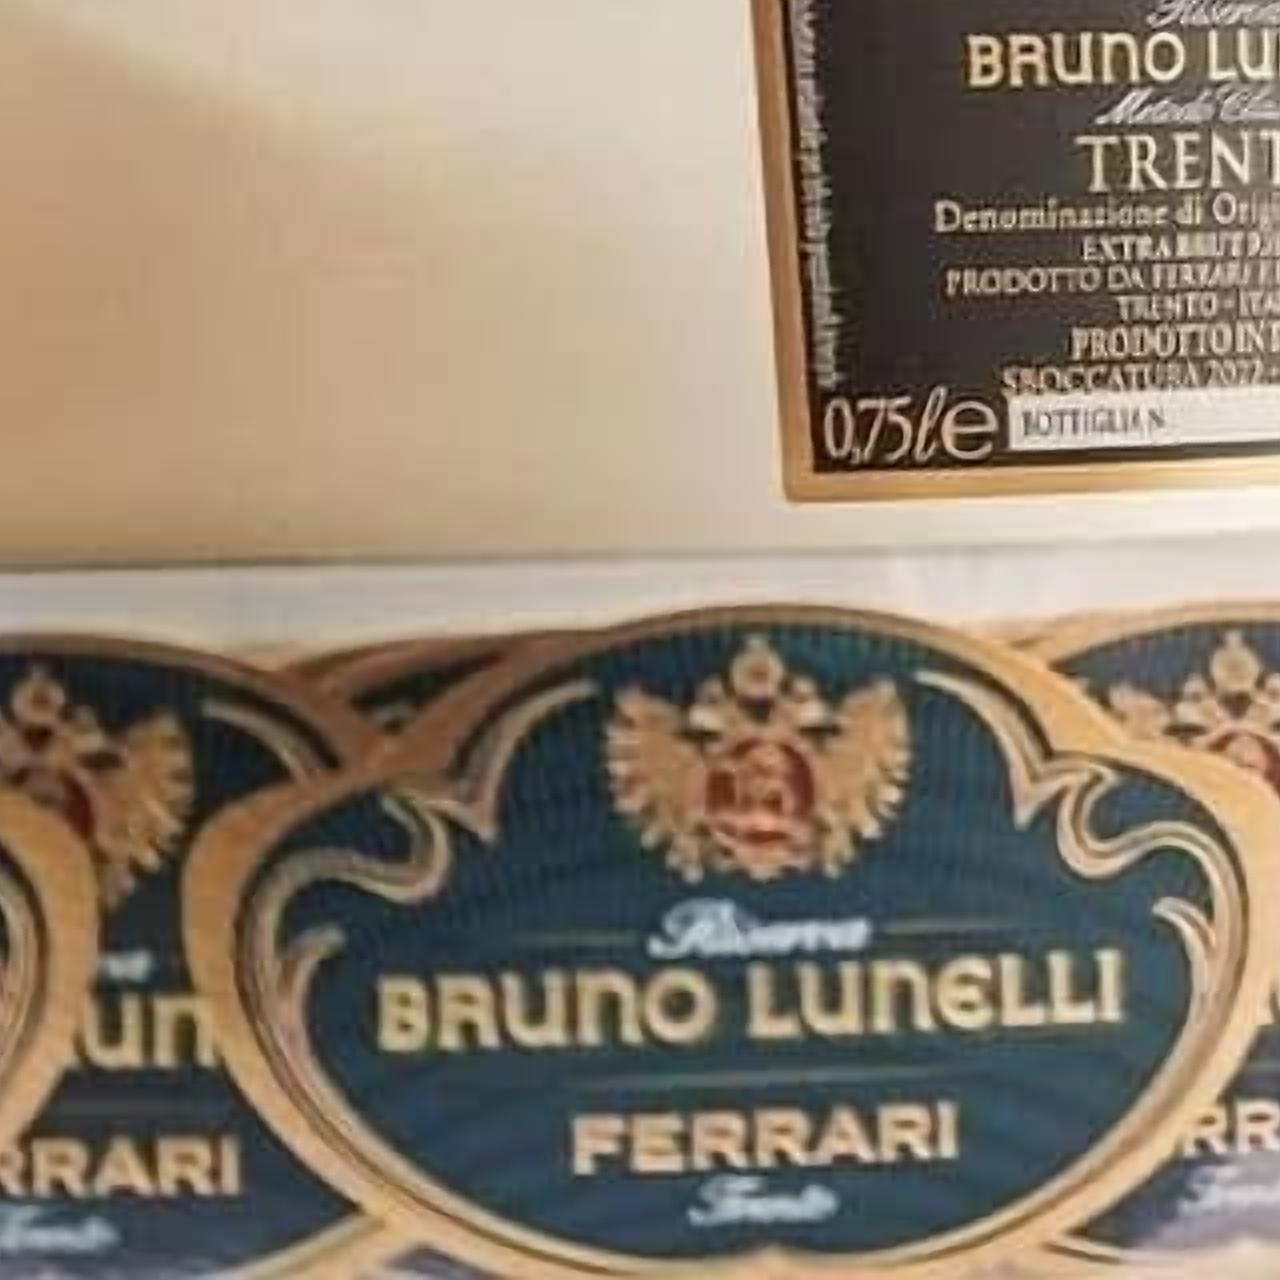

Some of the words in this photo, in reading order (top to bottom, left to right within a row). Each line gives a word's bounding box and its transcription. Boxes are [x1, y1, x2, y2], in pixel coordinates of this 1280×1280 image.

[967, 30, 1186, 88] BRUNO
[934, 197, 1170, 234] Denominazione
[1175, 193, 1202, 226] di
[1082, 234, 1171, 261] EXTRA
[946, 265, 1102, 296] PRODOTTO
[1071, 322, 1233, 360] PRODOTTO
[374, 968, 717, 1055] BRUNO
[745, 948, 1124, 1040] LUNELLI
[571, 1100, 961, 1177] FERRARI
